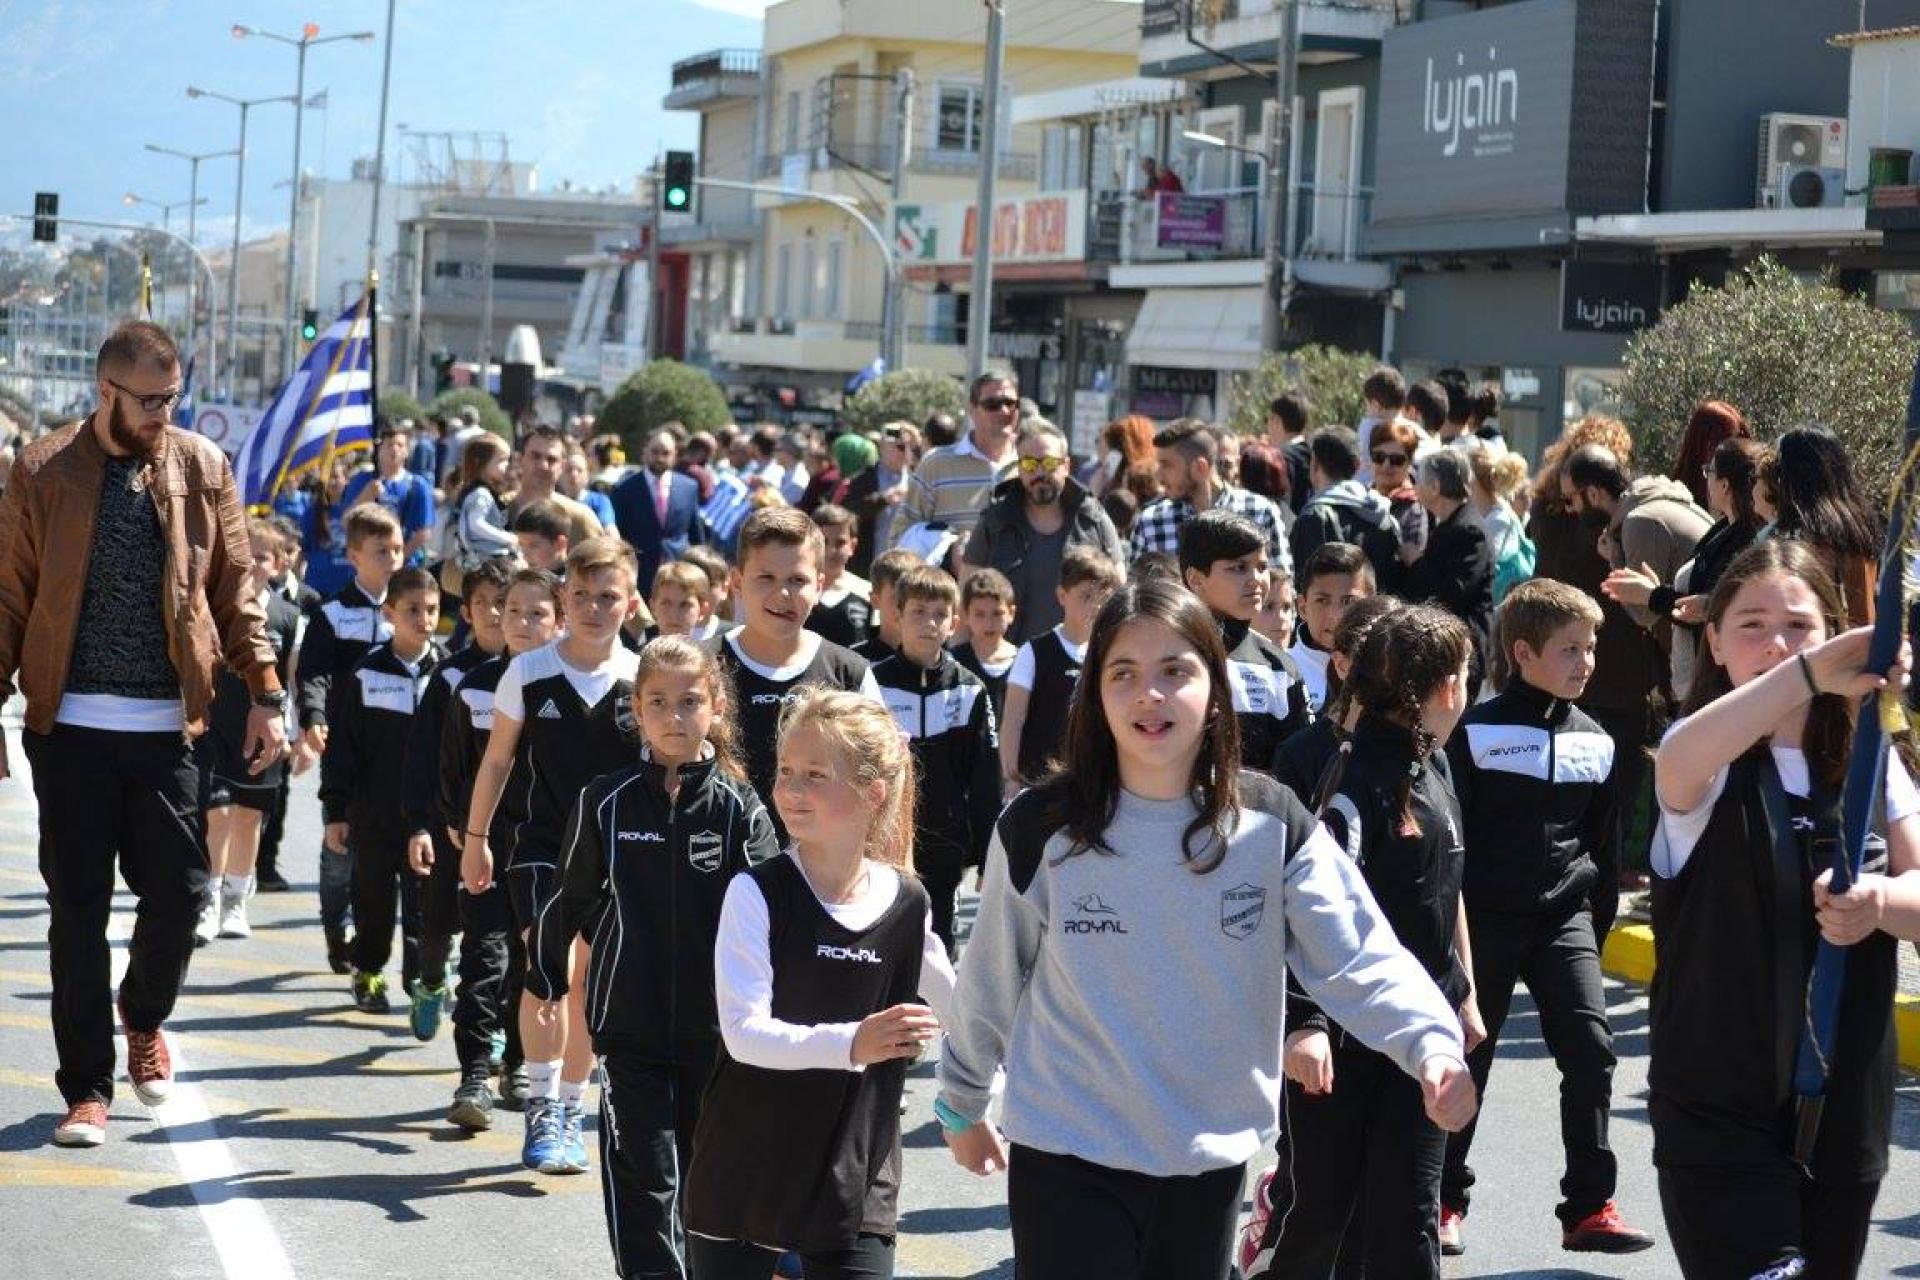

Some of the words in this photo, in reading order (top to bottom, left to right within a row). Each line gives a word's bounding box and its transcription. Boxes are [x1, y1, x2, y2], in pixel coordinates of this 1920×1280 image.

[1424, 46, 1518, 156] lujain
[1577, 296, 1646, 329] lujain
[617, 831, 666, 843] ROYAL
[1063, 919, 1129, 934] ROYAL
[817, 944, 882, 963] ROYAL
